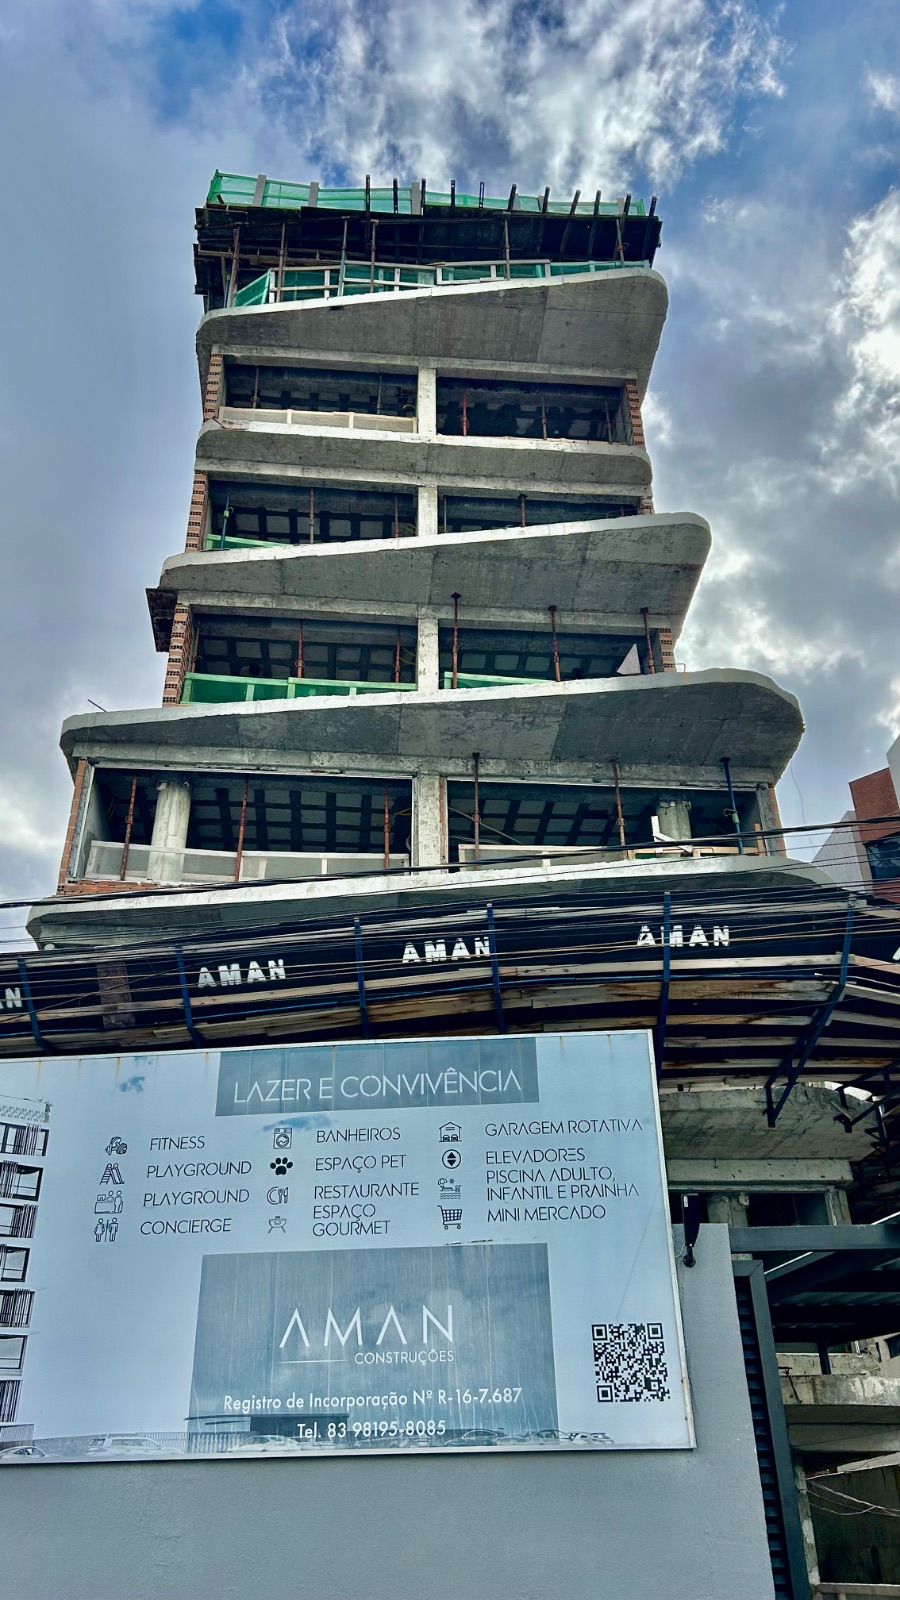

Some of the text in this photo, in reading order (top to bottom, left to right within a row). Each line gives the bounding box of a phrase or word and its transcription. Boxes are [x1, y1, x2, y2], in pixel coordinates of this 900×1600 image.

[636, 925, 730, 947] AMAN
[402, 936, 490, 963] AMAN
[198, 959, 286, 989] AMAN
[234, 1066, 521, 1104] LAZER E CONVIVÊNCIA
[316, 1126, 401, 1143] BANHEIROS
[485, 1118, 643, 1137] GARAGEM ROTATIVA
[150, 1136, 205, 1151] FITNESS
[315, 1154, 407, 1173] ESPAÇO PET
[486, 1147, 586, 1164] ELEVADORES
[147, 1161, 252, 1178] PLAYGROUND
[486, 1166, 616, 1184] PISCINA ADULTO,
[143, 1189, 250, 1207] PLAYGROUND
[314, 1182, 420, 1199] RESTAURANTE
[486, 1183, 640, 1201] INFANTIL E PRAINHA
[313, 1203, 376, 1221] ESPAÇO
[487, 1205, 606, 1222] MINI MERCADO
[140, 1218, 232, 1236] CONCIERGE
[312, 1220, 391, 1237] GOURMET
[279, 1304, 453, 1348] AMAN
[354, 1348, 455, 1366] CONSTRUÇÕES
[224, 1395, 281, 1413] Registro
[286, 1392, 304, 1409] de
[309, 1391, 407, 1412] Incorporação
[413, 1389, 433, 1405] Nº
[297, 1419, 446, 1440] Tel. 83 98195-8085
